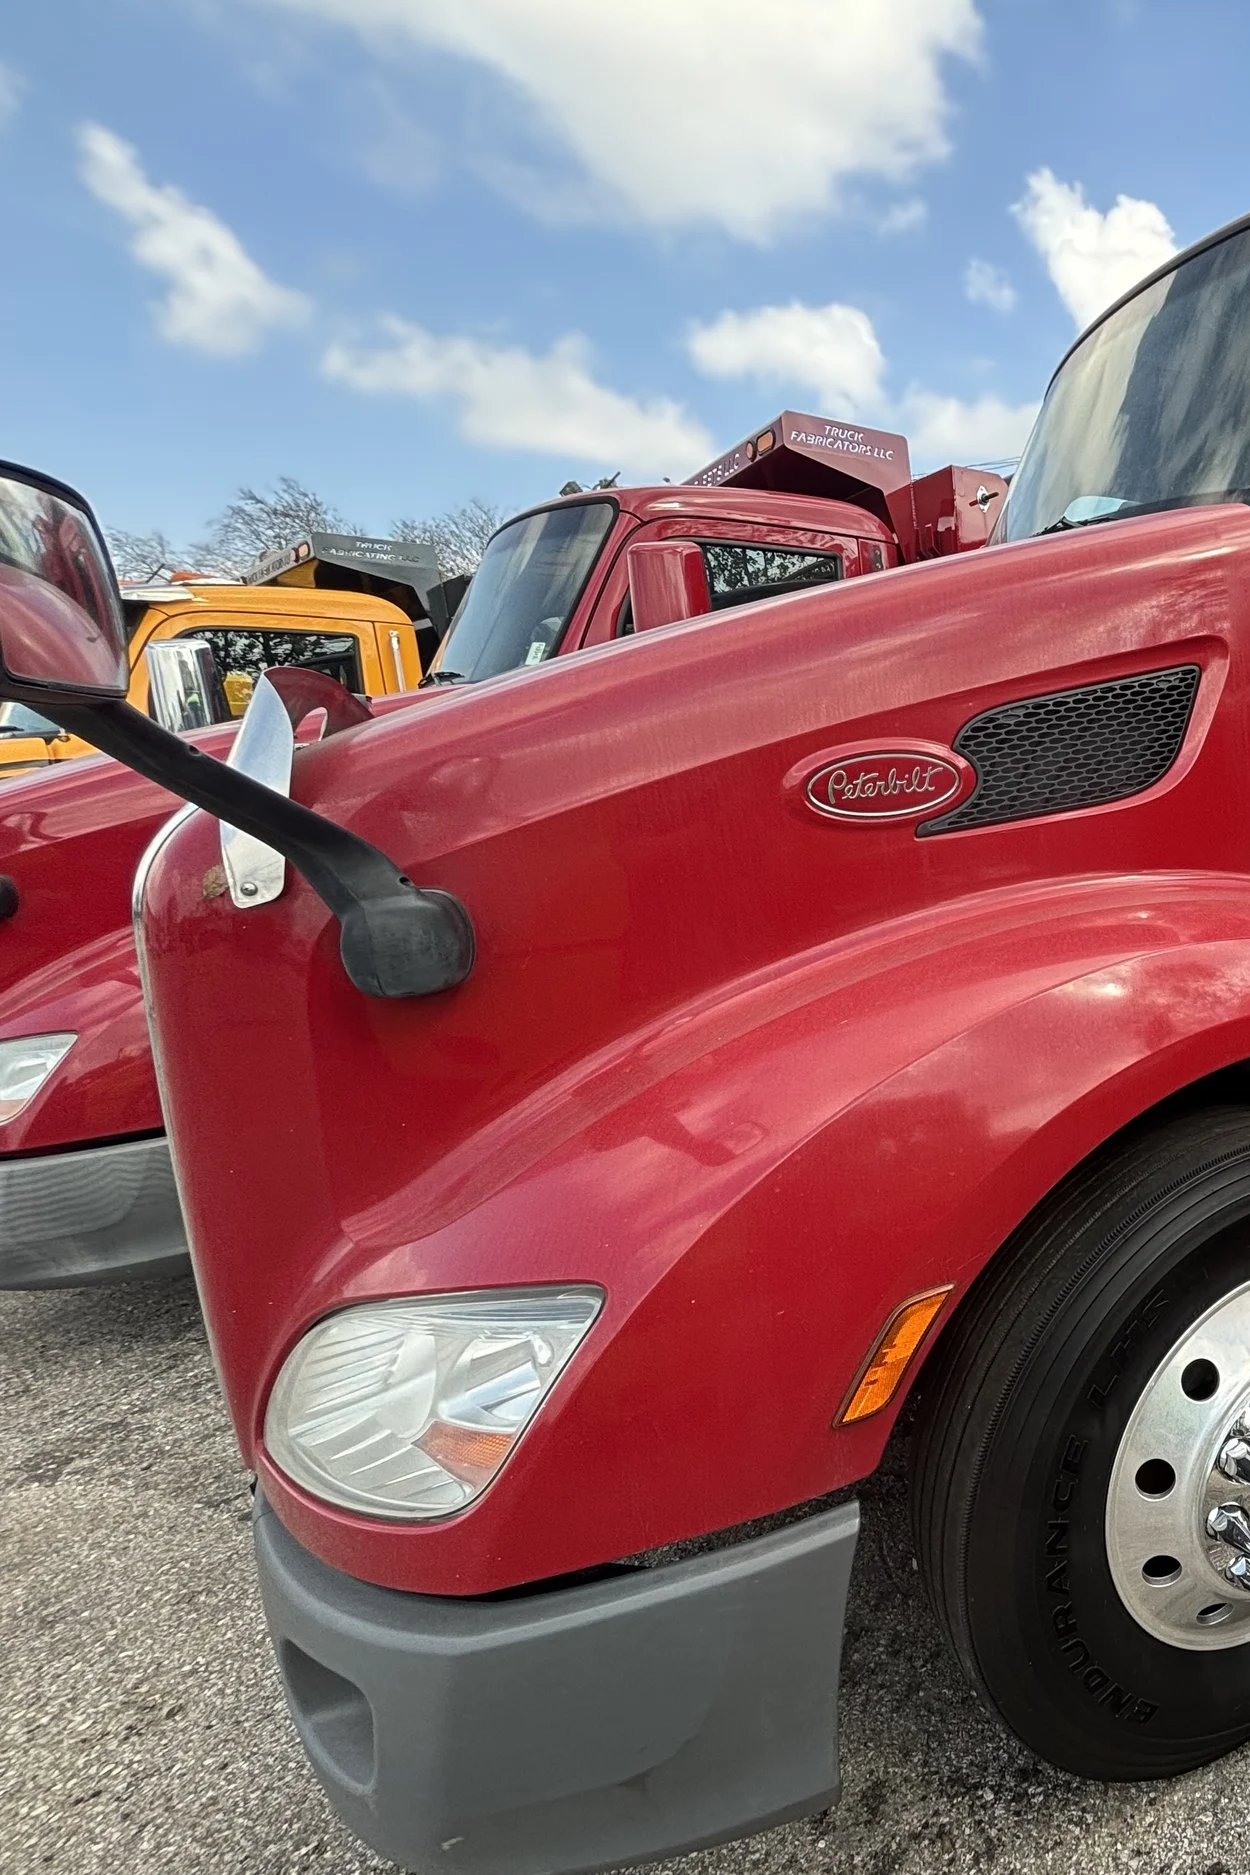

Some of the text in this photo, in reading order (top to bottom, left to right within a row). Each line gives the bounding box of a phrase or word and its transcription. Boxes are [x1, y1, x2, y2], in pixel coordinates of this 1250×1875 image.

[790, 431, 894, 460] FABRICATORS LLC
[824, 425, 864, 442] TRUCK
[355, 541, 393, 551] TRUCK
[827, 766, 944, 805] Peterbilt
[1043, 1433, 1160, 1727] ENDURANCE
